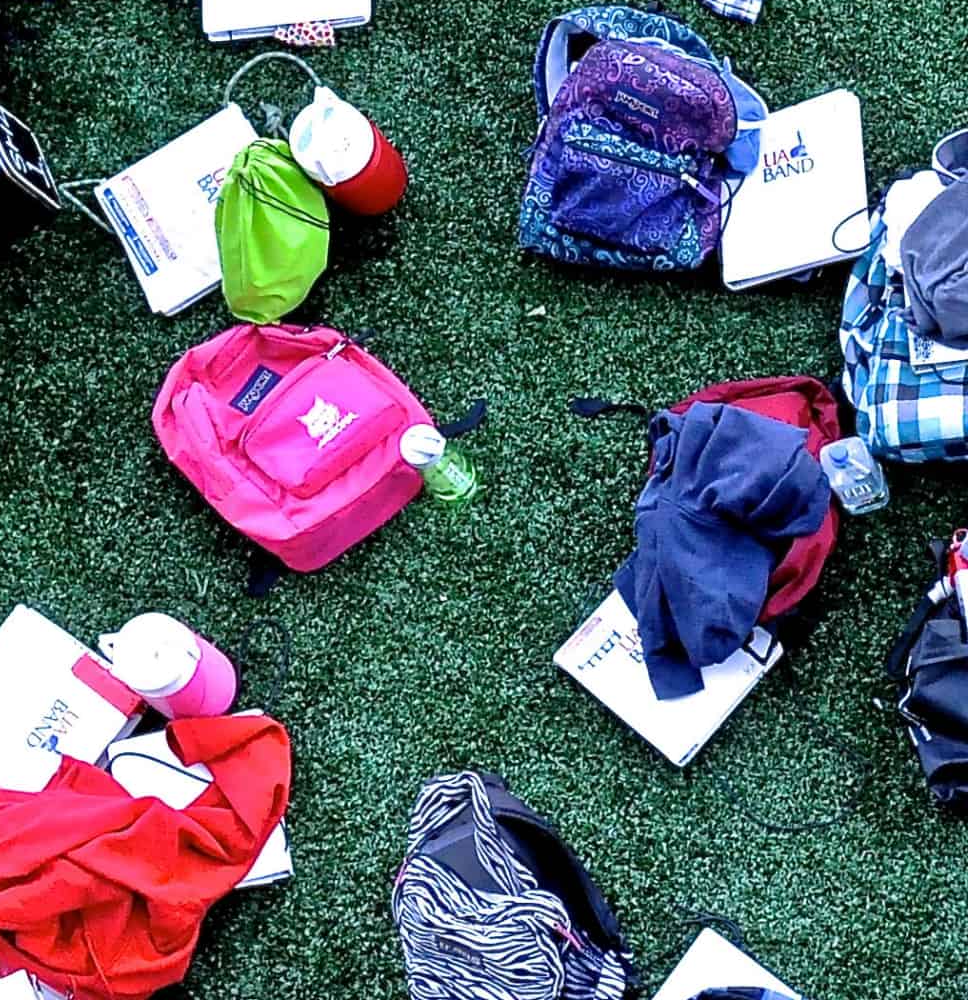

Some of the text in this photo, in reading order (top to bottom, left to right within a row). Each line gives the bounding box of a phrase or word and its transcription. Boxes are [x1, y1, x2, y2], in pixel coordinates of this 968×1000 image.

[763, 149, 790, 167] UA
[763, 158, 814, 183] BAND
[26, 698, 69, 748] BAND
